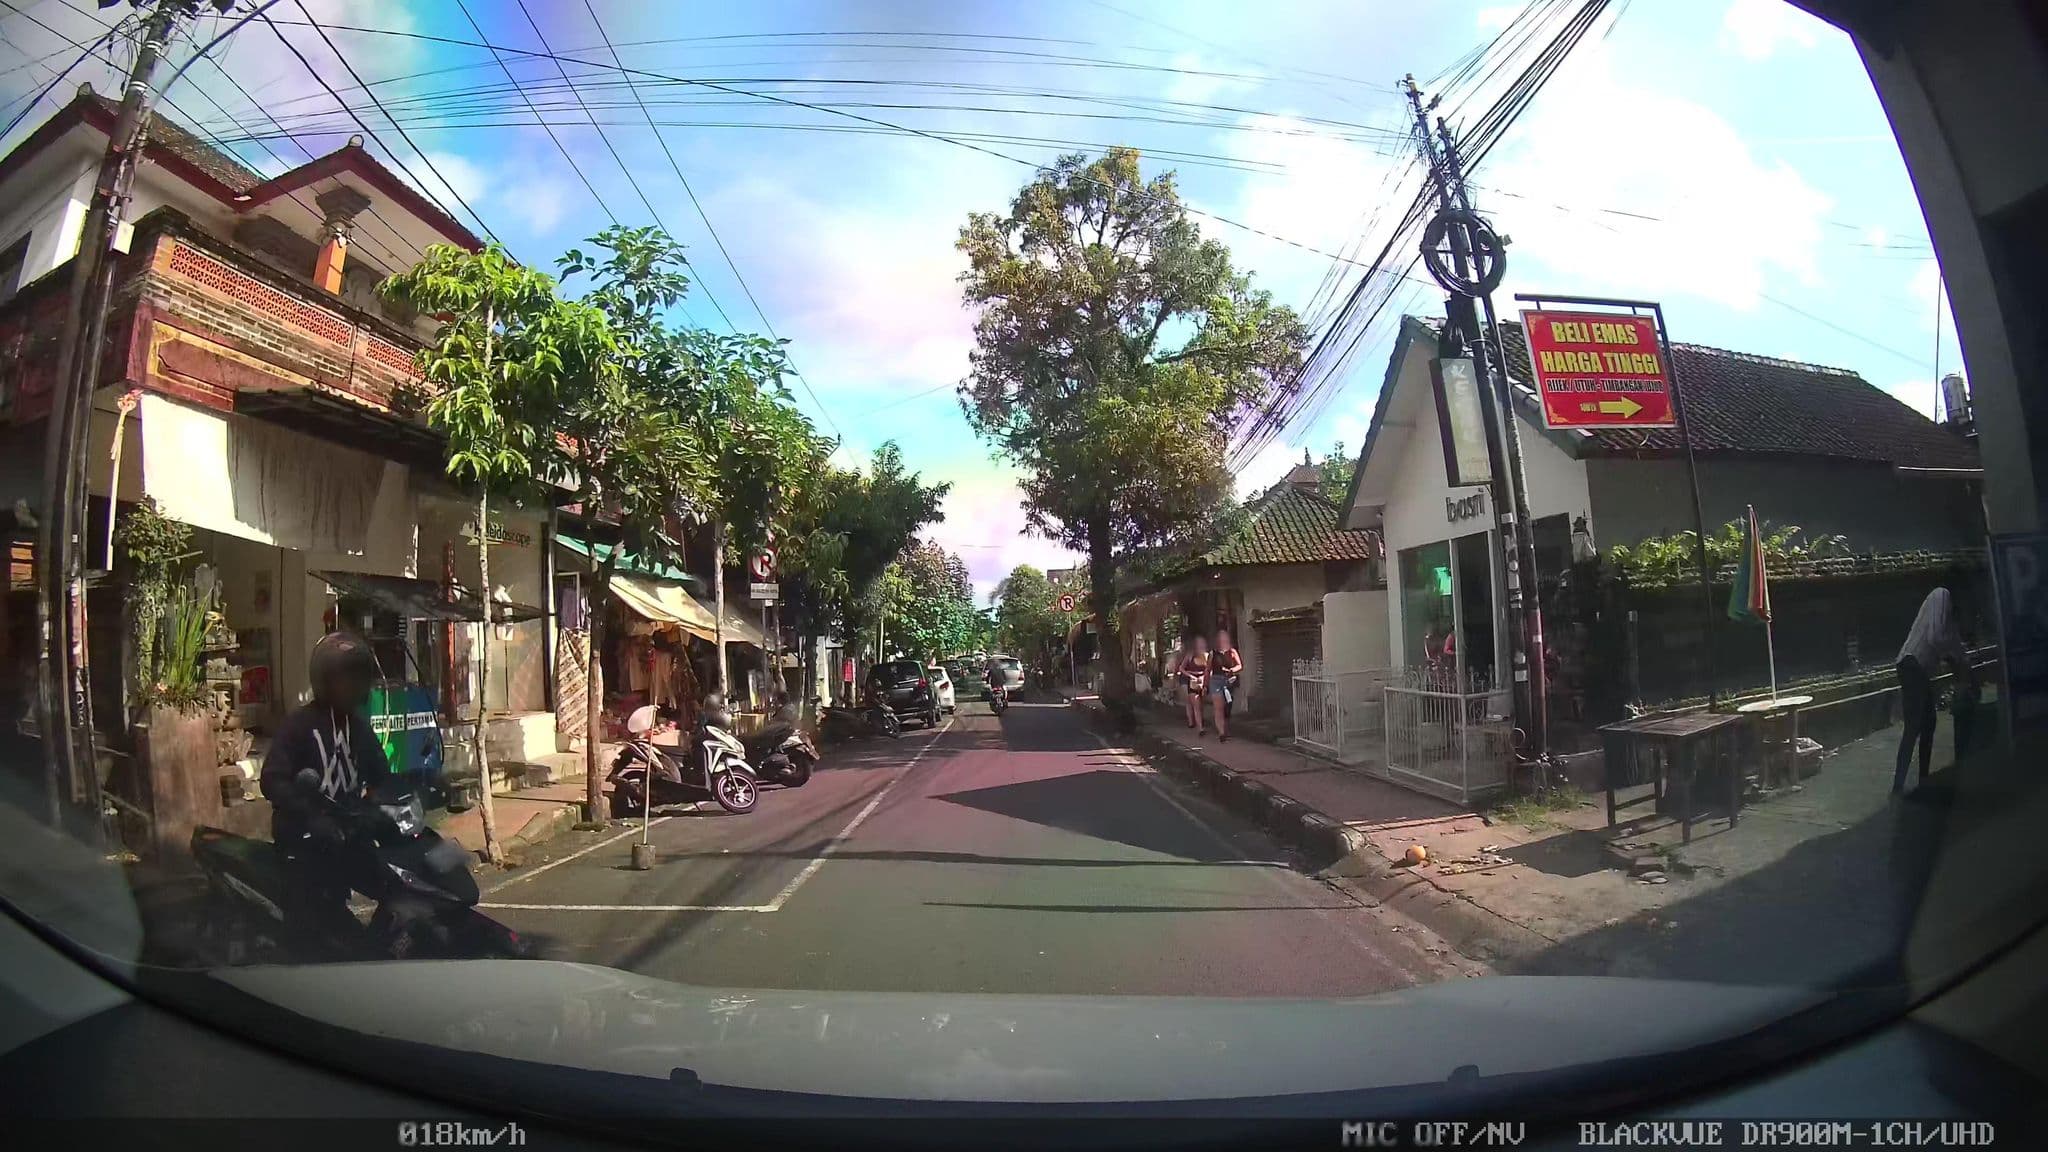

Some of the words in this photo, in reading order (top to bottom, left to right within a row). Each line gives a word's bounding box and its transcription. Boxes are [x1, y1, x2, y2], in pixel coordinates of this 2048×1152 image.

[1551, 321, 1591, 343] BELI
[1591, 322, 1639, 345] EMAS
[1540, 350, 1604, 373] HARGA
[1603, 351, 1661, 374] TINGGI
[1574, 379, 1597, 393] UTUH
[473, 520, 531, 547] Kleidoscope
